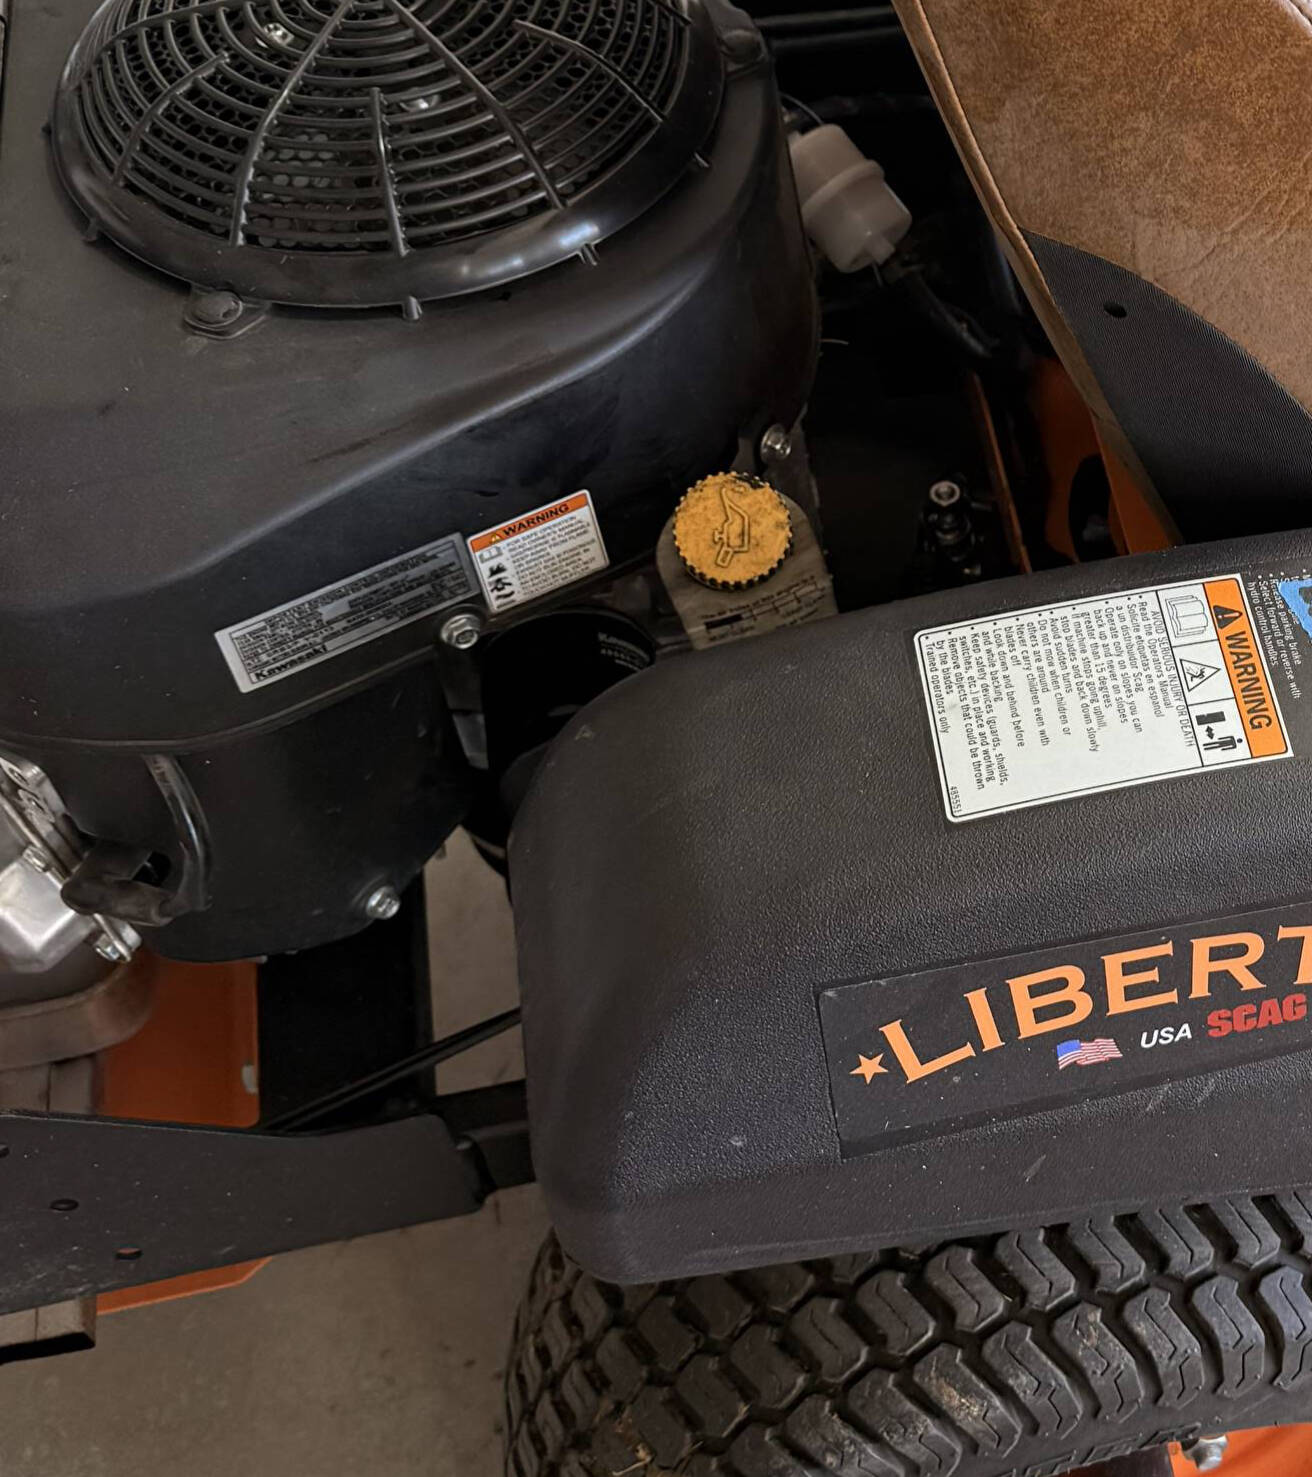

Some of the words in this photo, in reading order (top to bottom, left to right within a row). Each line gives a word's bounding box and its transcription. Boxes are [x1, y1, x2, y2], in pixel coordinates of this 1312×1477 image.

[503, 504, 569, 536] WARNING
[1093, 608, 1106, 629] back
[1137, 601, 1151, 622] Read
[1247, 581, 1260, 604] hydro
[1255, 606, 1271, 634] control
[1026, 621, 1039, 648] others
[1037, 618, 1048, 631] Do
[1048, 617, 1062, 640] Avoid
[1059, 615, 1071, 633] stop
[1080, 611, 1096, 640] greater
[1104, 606, 1119, 639] Operate
[1143, 623, 1153, 636] the
[1150, 610, 1166, 635] AVOID
[1259, 580, 1273, 605] Select
[1266, 607, 1283, 637] forward
[1279, 649, 1294, 679] reverse
[935, 639, 946, 650] by
[970, 632, 981, 654] Keep
[981, 630, 993, 646] and
[992, 627, 1005, 649] Look
[1003, 625, 1017, 653] blades
[1015, 623, 1027, 647] Never
[1040, 632, 1051, 647] not
[1072, 620, 1088, 654] machine
[1098, 630, 1108, 641] up
[1279, 611, 1294, 640] parking
[1289, 641, 1302, 665] brake
[925, 641, 939, 673] Trained
[938, 651, 948, 666] the
[947, 637, 961, 670] Remove
[985, 647, 997, 668] while
[1020, 649, 1032, 671] carry
[1032, 649, 1042, 663] are
[1044, 648, 1055, 667] mow
[1054, 641, 1068, 671] sudden
[1064, 634, 1077, 662] blades
[1089, 642, 1101, 660] than
[1101, 642, 1113, 658] and
[1117, 612, 1126, 623] un
[1132, 671, 1144, 693] Scag
[1147, 638, 1164, 679] Operators
[1157, 636, 1175, 672] SERIOUS
[254, 646, 328, 680] Kawasaki
[974, 655, 987, 680] safety
[997, 650, 1009, 672] down
[1071, 664, 1083, 679] and
[1081, 656, 1093, 679] stops
[1094, 662, 1106, 673] 15
[1106, 659, 1118, 681] never
[941, 666, 954, 695] blades
[954, 671, 968, 702] objects
[989, 669, 1004, 702] backing
[1002, 674, 1014, 689] and
[1026, 672, 1040, 705] children
[1036, 665, 1051, 693] around
[1048, 668, 1061, 691] when
[1061, 672, 1073, 694] turns
[1075, 680, 1088, 701] back
[1120, 672, 1134, 699] slopes
[1144, 673, 1154, 684] en
[1167, 673, 1183, 702] INJURY
[1225, 630, 1272, 730] WARNING
[930, 674, 946, 715] operators
[980, 682, 994, 714] devices
[1005, 690, 1020, 718] behind
[1085, 680, 1100, 704] going
[1097, 675, 1113, 709] degrees
[1158, 680, 1174, 709] Manual
[960, 703, 973, 721] that
[972, 706, 985, 729] place
[1033, 707, 1045, 727] even
[1054, 692, 1068, 725] children
[1080, 702, 1092, 725] down
[1114, 696, 1128, 724] slopes
[1125, 700, 1138, 716] you
[1175, 704, 1187, 717] OR
[964, 722, 978, 746] could
[1010, 719, 1025, 747] before
[1038, 728, 1050, 746] with
[1062, 726, 1071, 735] or
[1131, 717, 1143, 733] can
[1179, 718, 1195, 747] DEATH
[978, 731, 990, 747] and
[1086, 726, 1100, 752] slowly
[969, 746, 979, 759] be
[972, 760, 985, 790] thrown
[981, 748, 996, 783] working
[1207, 994, 1307, 1038] SCAG
[1140, 1023, 1193, 1049] USA
